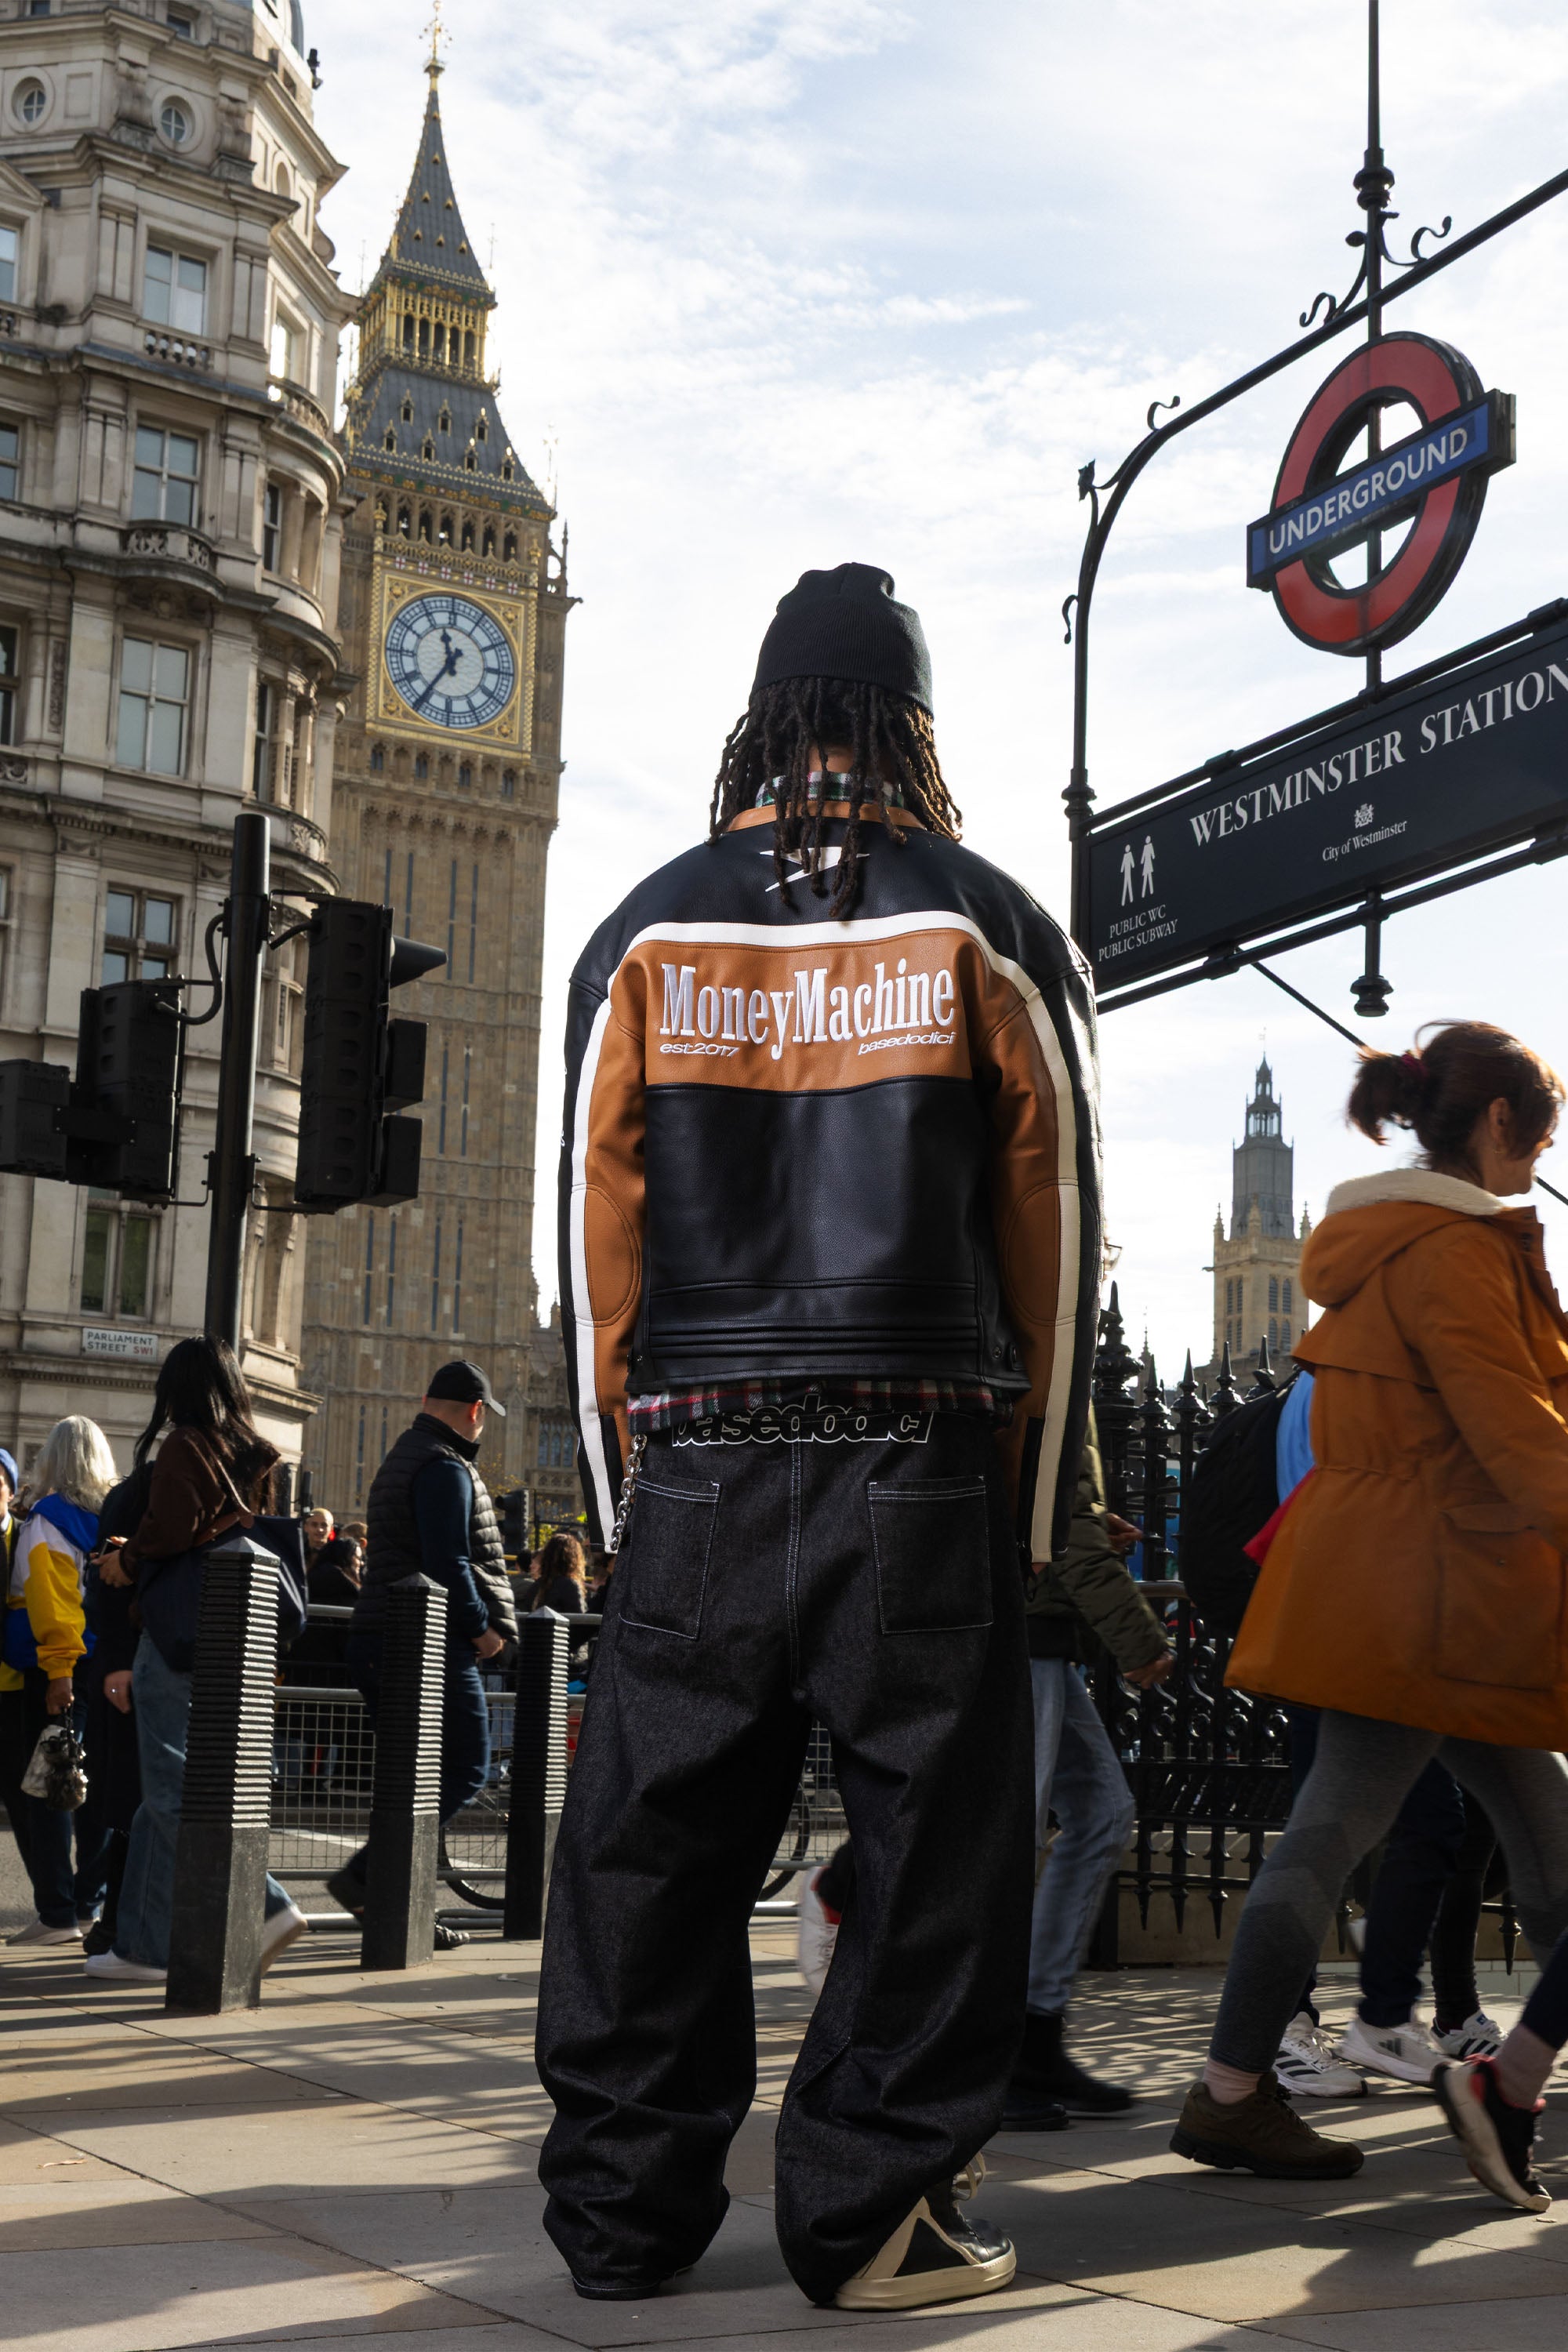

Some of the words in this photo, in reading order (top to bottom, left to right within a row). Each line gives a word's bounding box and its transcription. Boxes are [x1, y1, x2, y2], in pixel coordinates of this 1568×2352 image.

[1269, 427, 1468, 554] UNDERGROUND
[1189, 730, 1406, 848] WESTMINSTER
[1420, 658, 1568, 754] STATION
[1323, 847, 1340, 862] City
[1341, 838, 1352, 855] of
[1352, 821, 1407, 849] Westminster
[1109, 912, 1146, 938] PUBLIC
[1148, 904, 1167, 923] WC
[1098, 936, 1134, 962] PUBLIC
[1136, 919, 1178, 947] SUBWAY
[659, 958, 955, 1061] MoneyMachine
[659, 1042, 739, 1057] est2017
[858, 1031, 956, 1055] basedodici
[87, 1331, 153, 1346] PARLIAMENT
[87, 1341, 127, 1352] STREET
[133, 1346, 154, 1356] SW1
